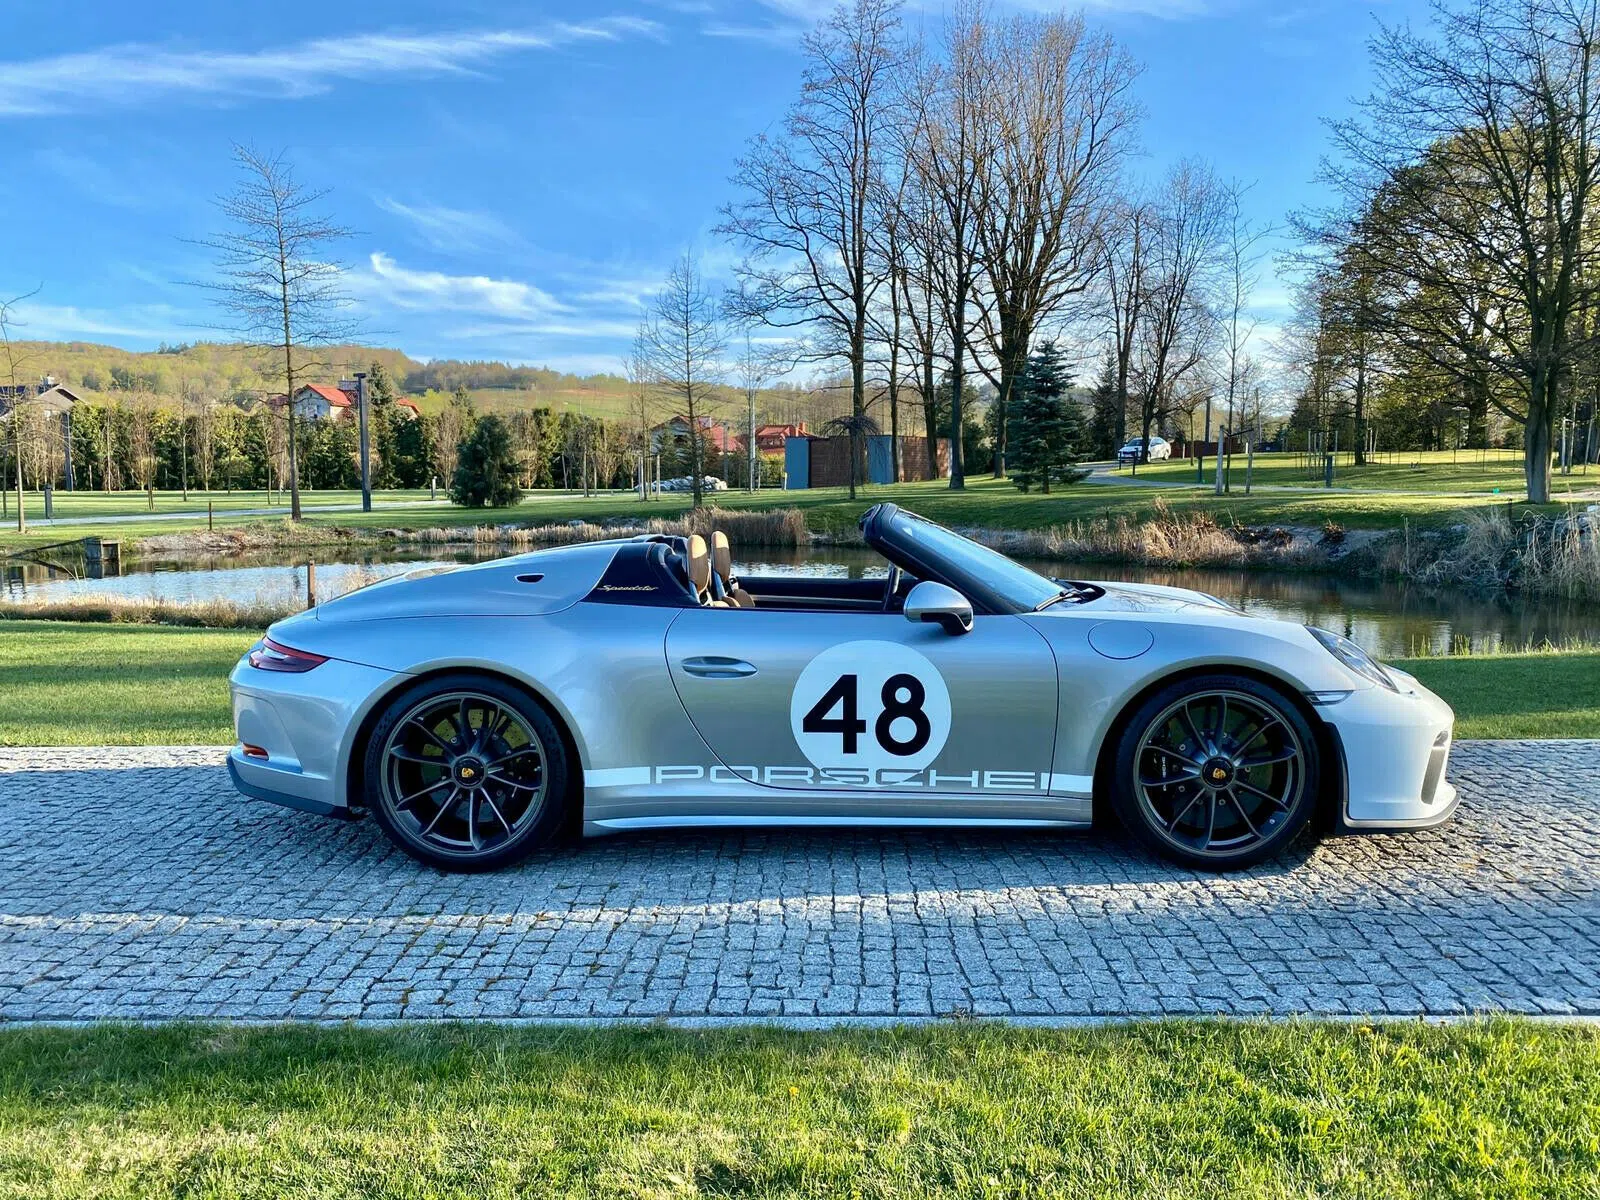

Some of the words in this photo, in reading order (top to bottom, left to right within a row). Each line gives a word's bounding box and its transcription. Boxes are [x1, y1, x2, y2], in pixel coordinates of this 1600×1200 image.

[597, 584, 659, 592] Speedster
[802, 673, 931, 757] 48
[655, 766, 1035, 789] PORSCHE
